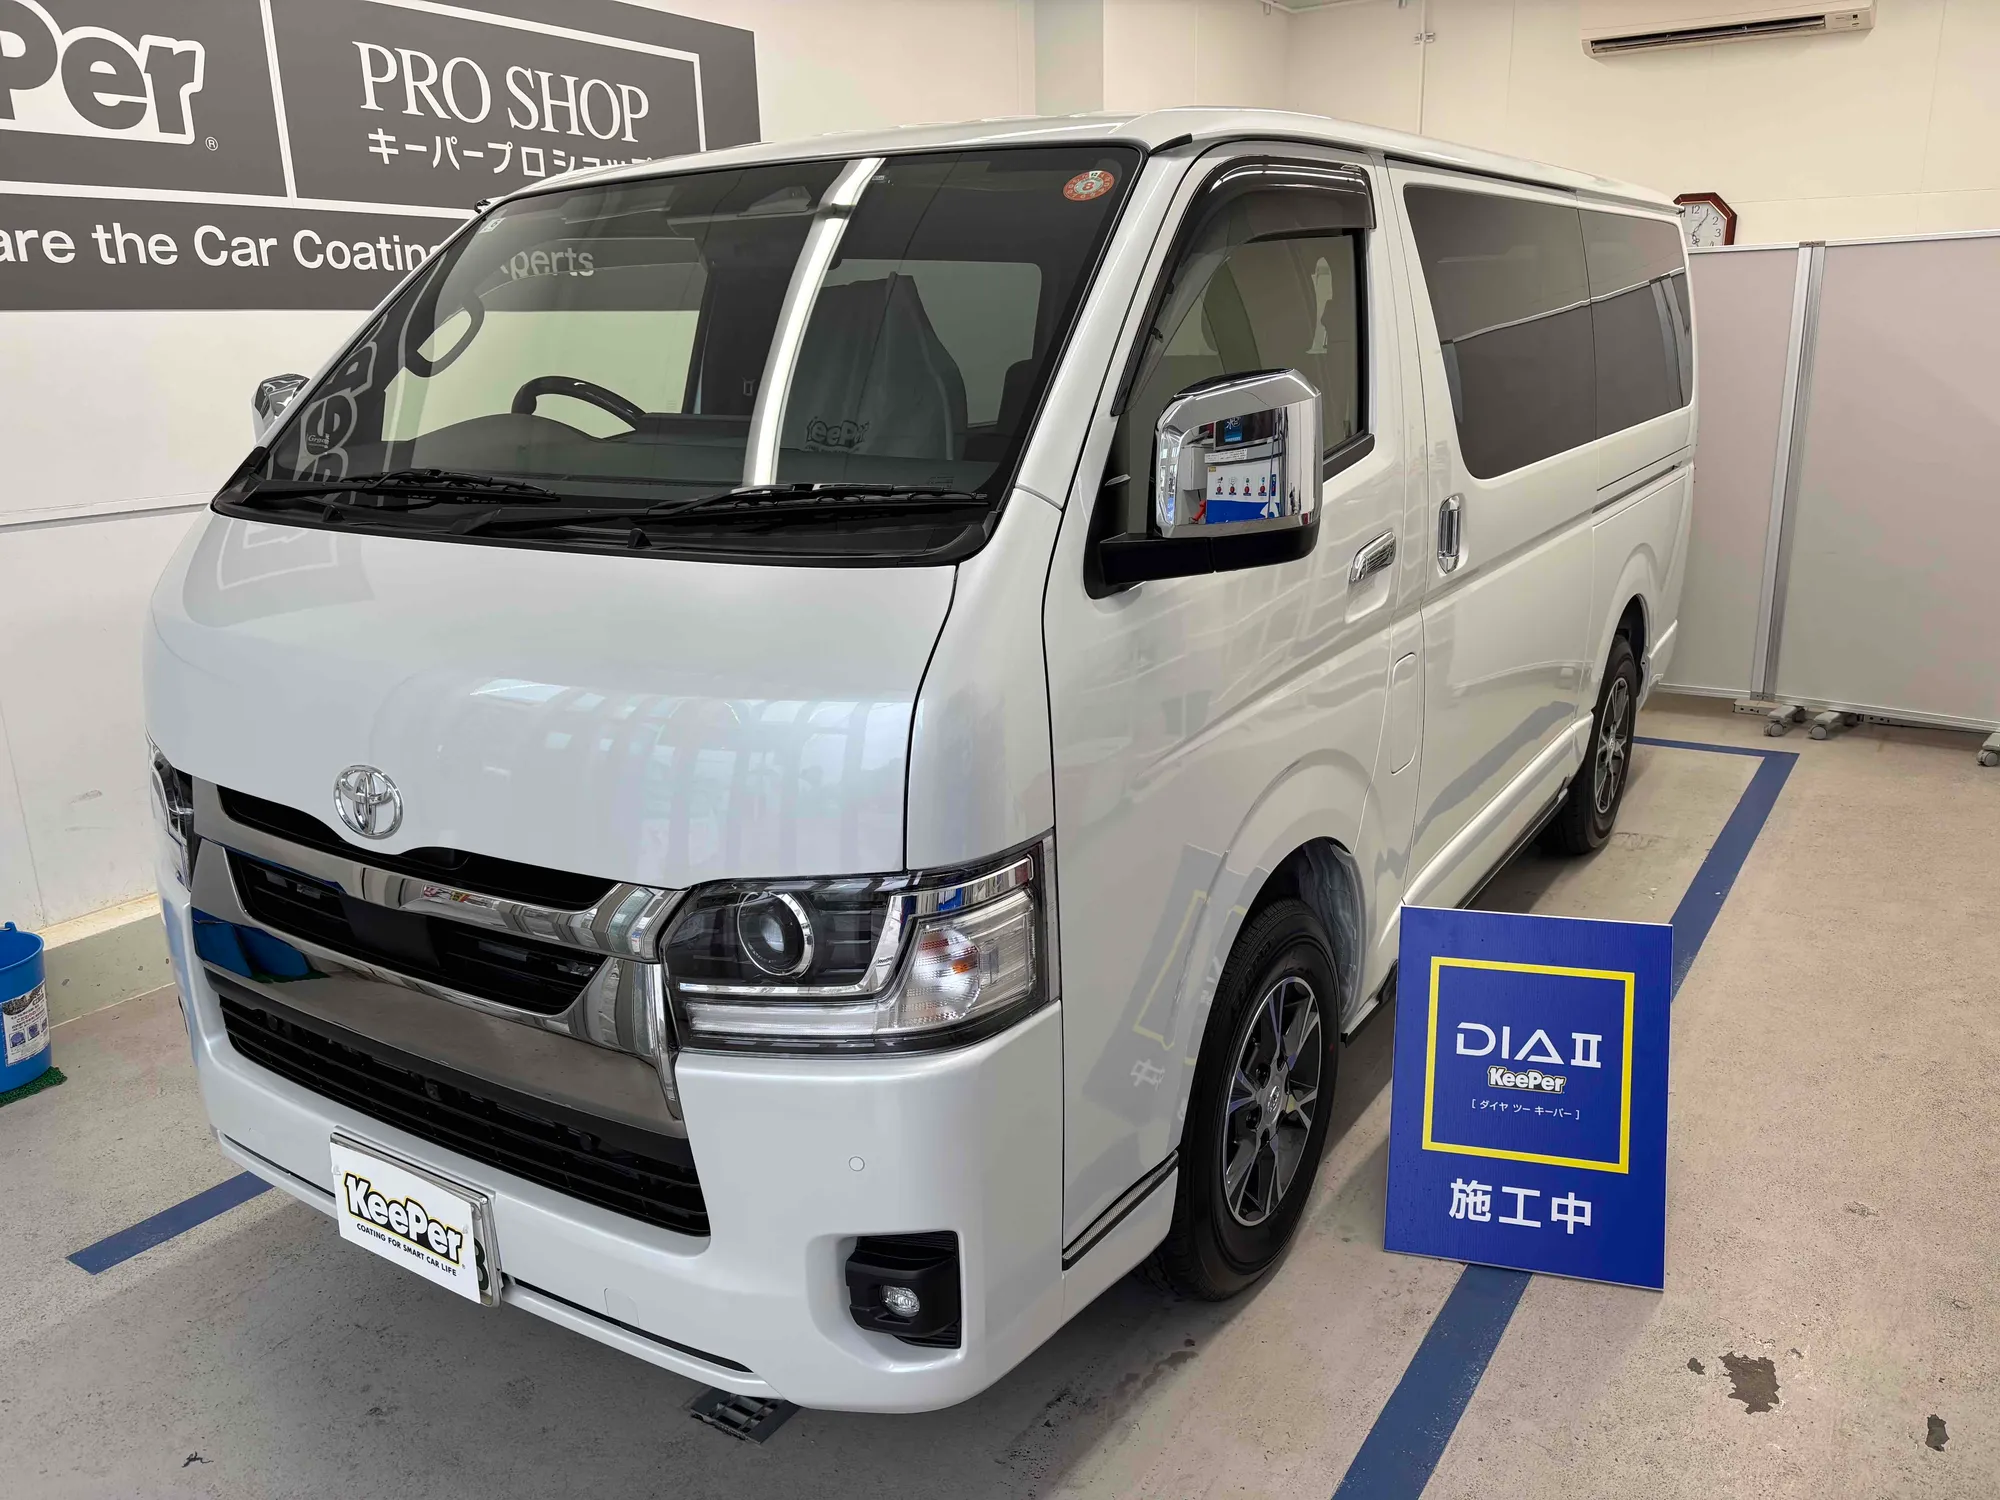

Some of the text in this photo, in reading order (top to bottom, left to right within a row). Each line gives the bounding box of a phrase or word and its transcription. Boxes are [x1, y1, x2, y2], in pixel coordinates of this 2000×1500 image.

[352, 40, 650, 143] PRO SHOP
[0, 228, 76, 264] are
[91, 222, 178, 265] the
[194, 225, 278, 267] Car
[293, 229, 443, 271] Coatin
[1456, 1022, 1565, 1065] DIA
[1487, 1065, 1567, 1094] KeePer
[344, 1172, 463, 1264] KeePer
[1449, 1178, 1593, 1235] 施工中
[356, 1223, 457, 1277] COATING FOR SMART CAR LIFE
